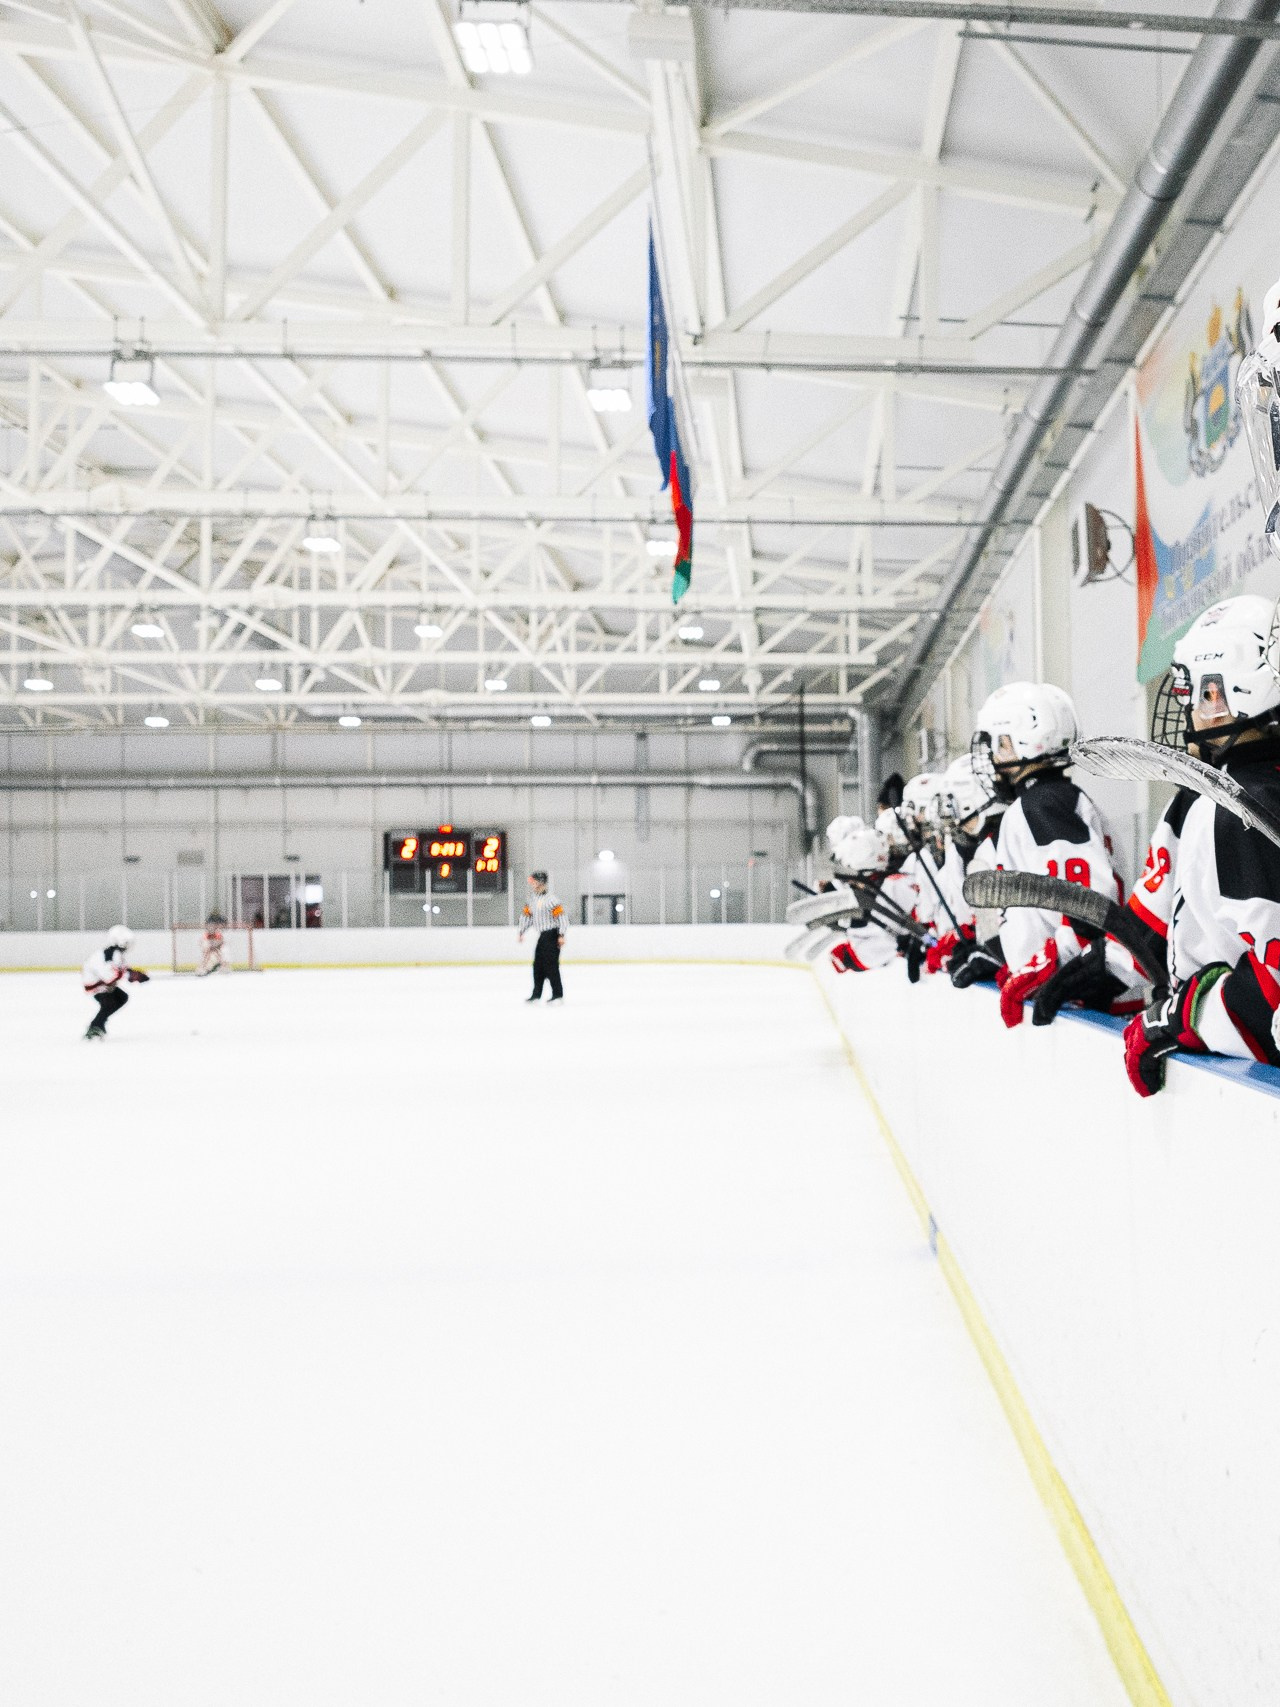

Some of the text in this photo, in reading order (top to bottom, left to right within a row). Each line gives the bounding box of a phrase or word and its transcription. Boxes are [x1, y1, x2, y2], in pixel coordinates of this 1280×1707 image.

[1195, 652, 1224, 662] CCM
[401, 837, 418, 860] 2
[483, 837, 499, 859] 2
